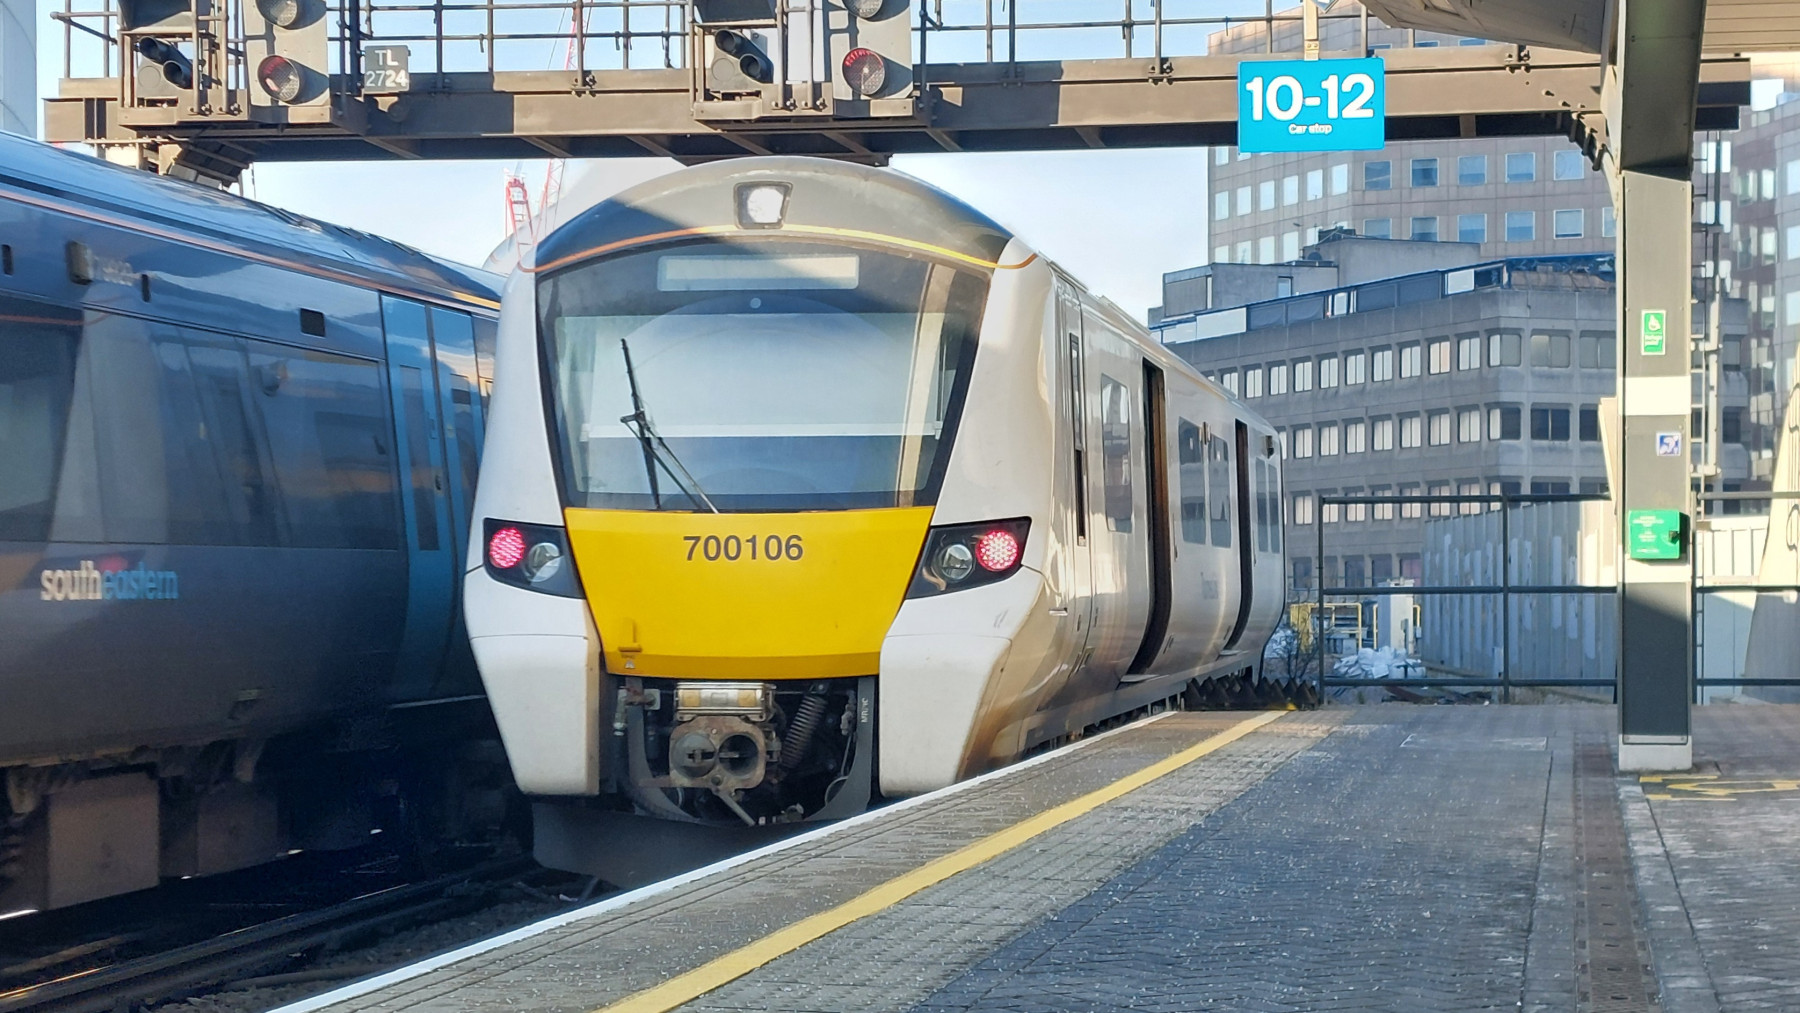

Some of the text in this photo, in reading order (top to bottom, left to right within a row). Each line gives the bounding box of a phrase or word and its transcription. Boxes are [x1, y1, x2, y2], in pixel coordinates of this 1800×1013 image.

[374, 49, 399, 66] TL
[365, 69, 408, 88] 2724
[1245, 73, 1376, 121] 10-12
[1288, 123, 1333, 136] Car stop
[683, 534, 804, 561] 700106
[40, 560, 178, 601] southeastern
